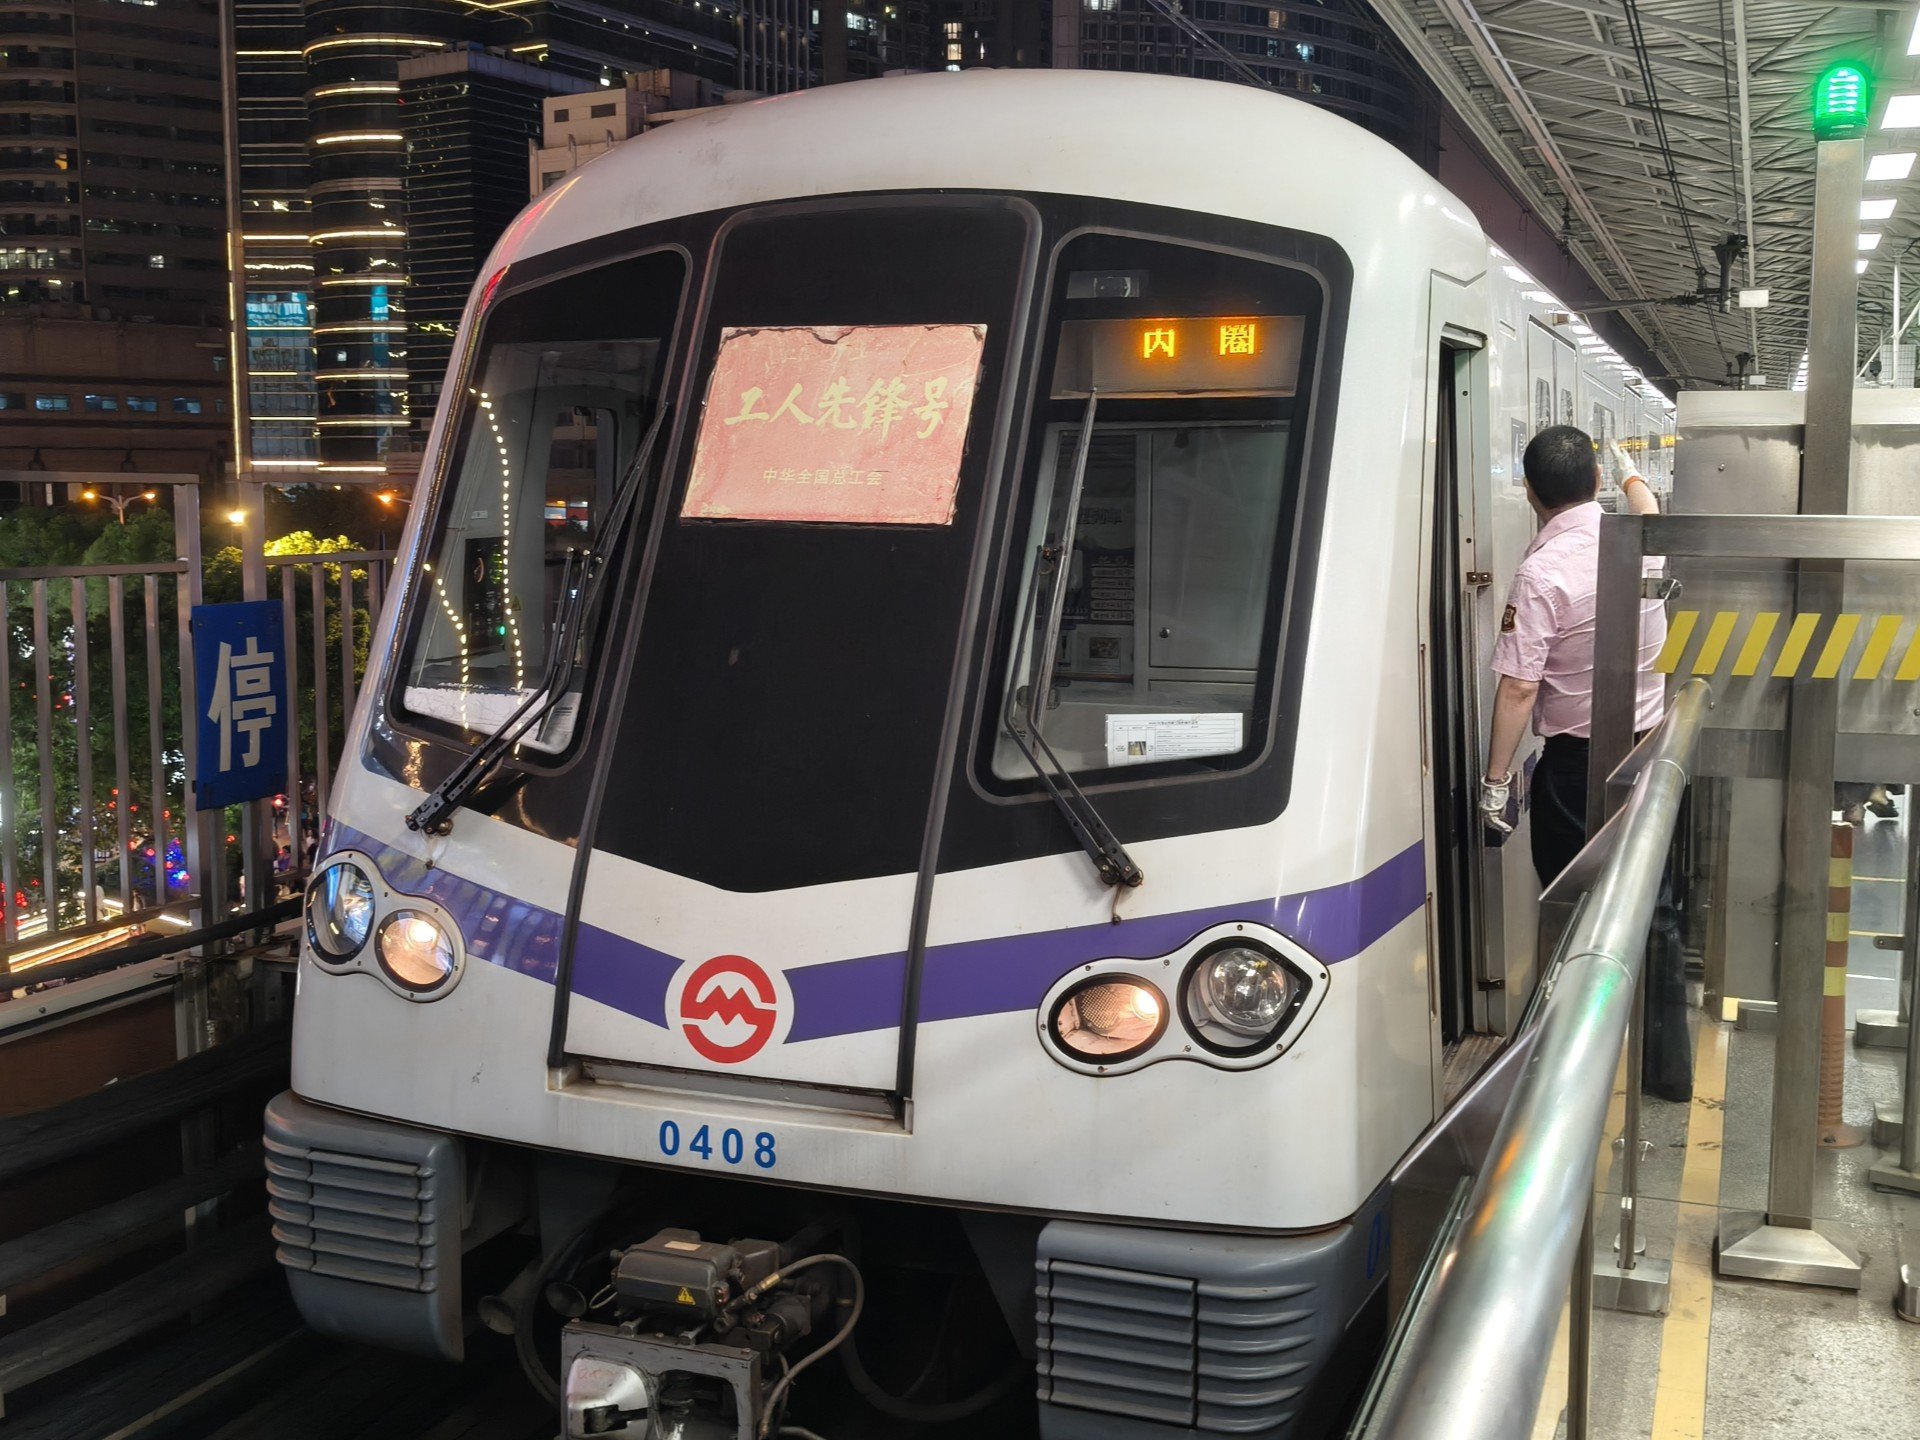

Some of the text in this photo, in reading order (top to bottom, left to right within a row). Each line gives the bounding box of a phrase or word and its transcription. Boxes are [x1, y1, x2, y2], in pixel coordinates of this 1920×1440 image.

[724, 376, 949, 440] 工人先锋号
[762, 467, 883, 487] 中华全国总工会
[207, 636, 277, 772] 停
[658, 1119, 777, 1169] 0408
